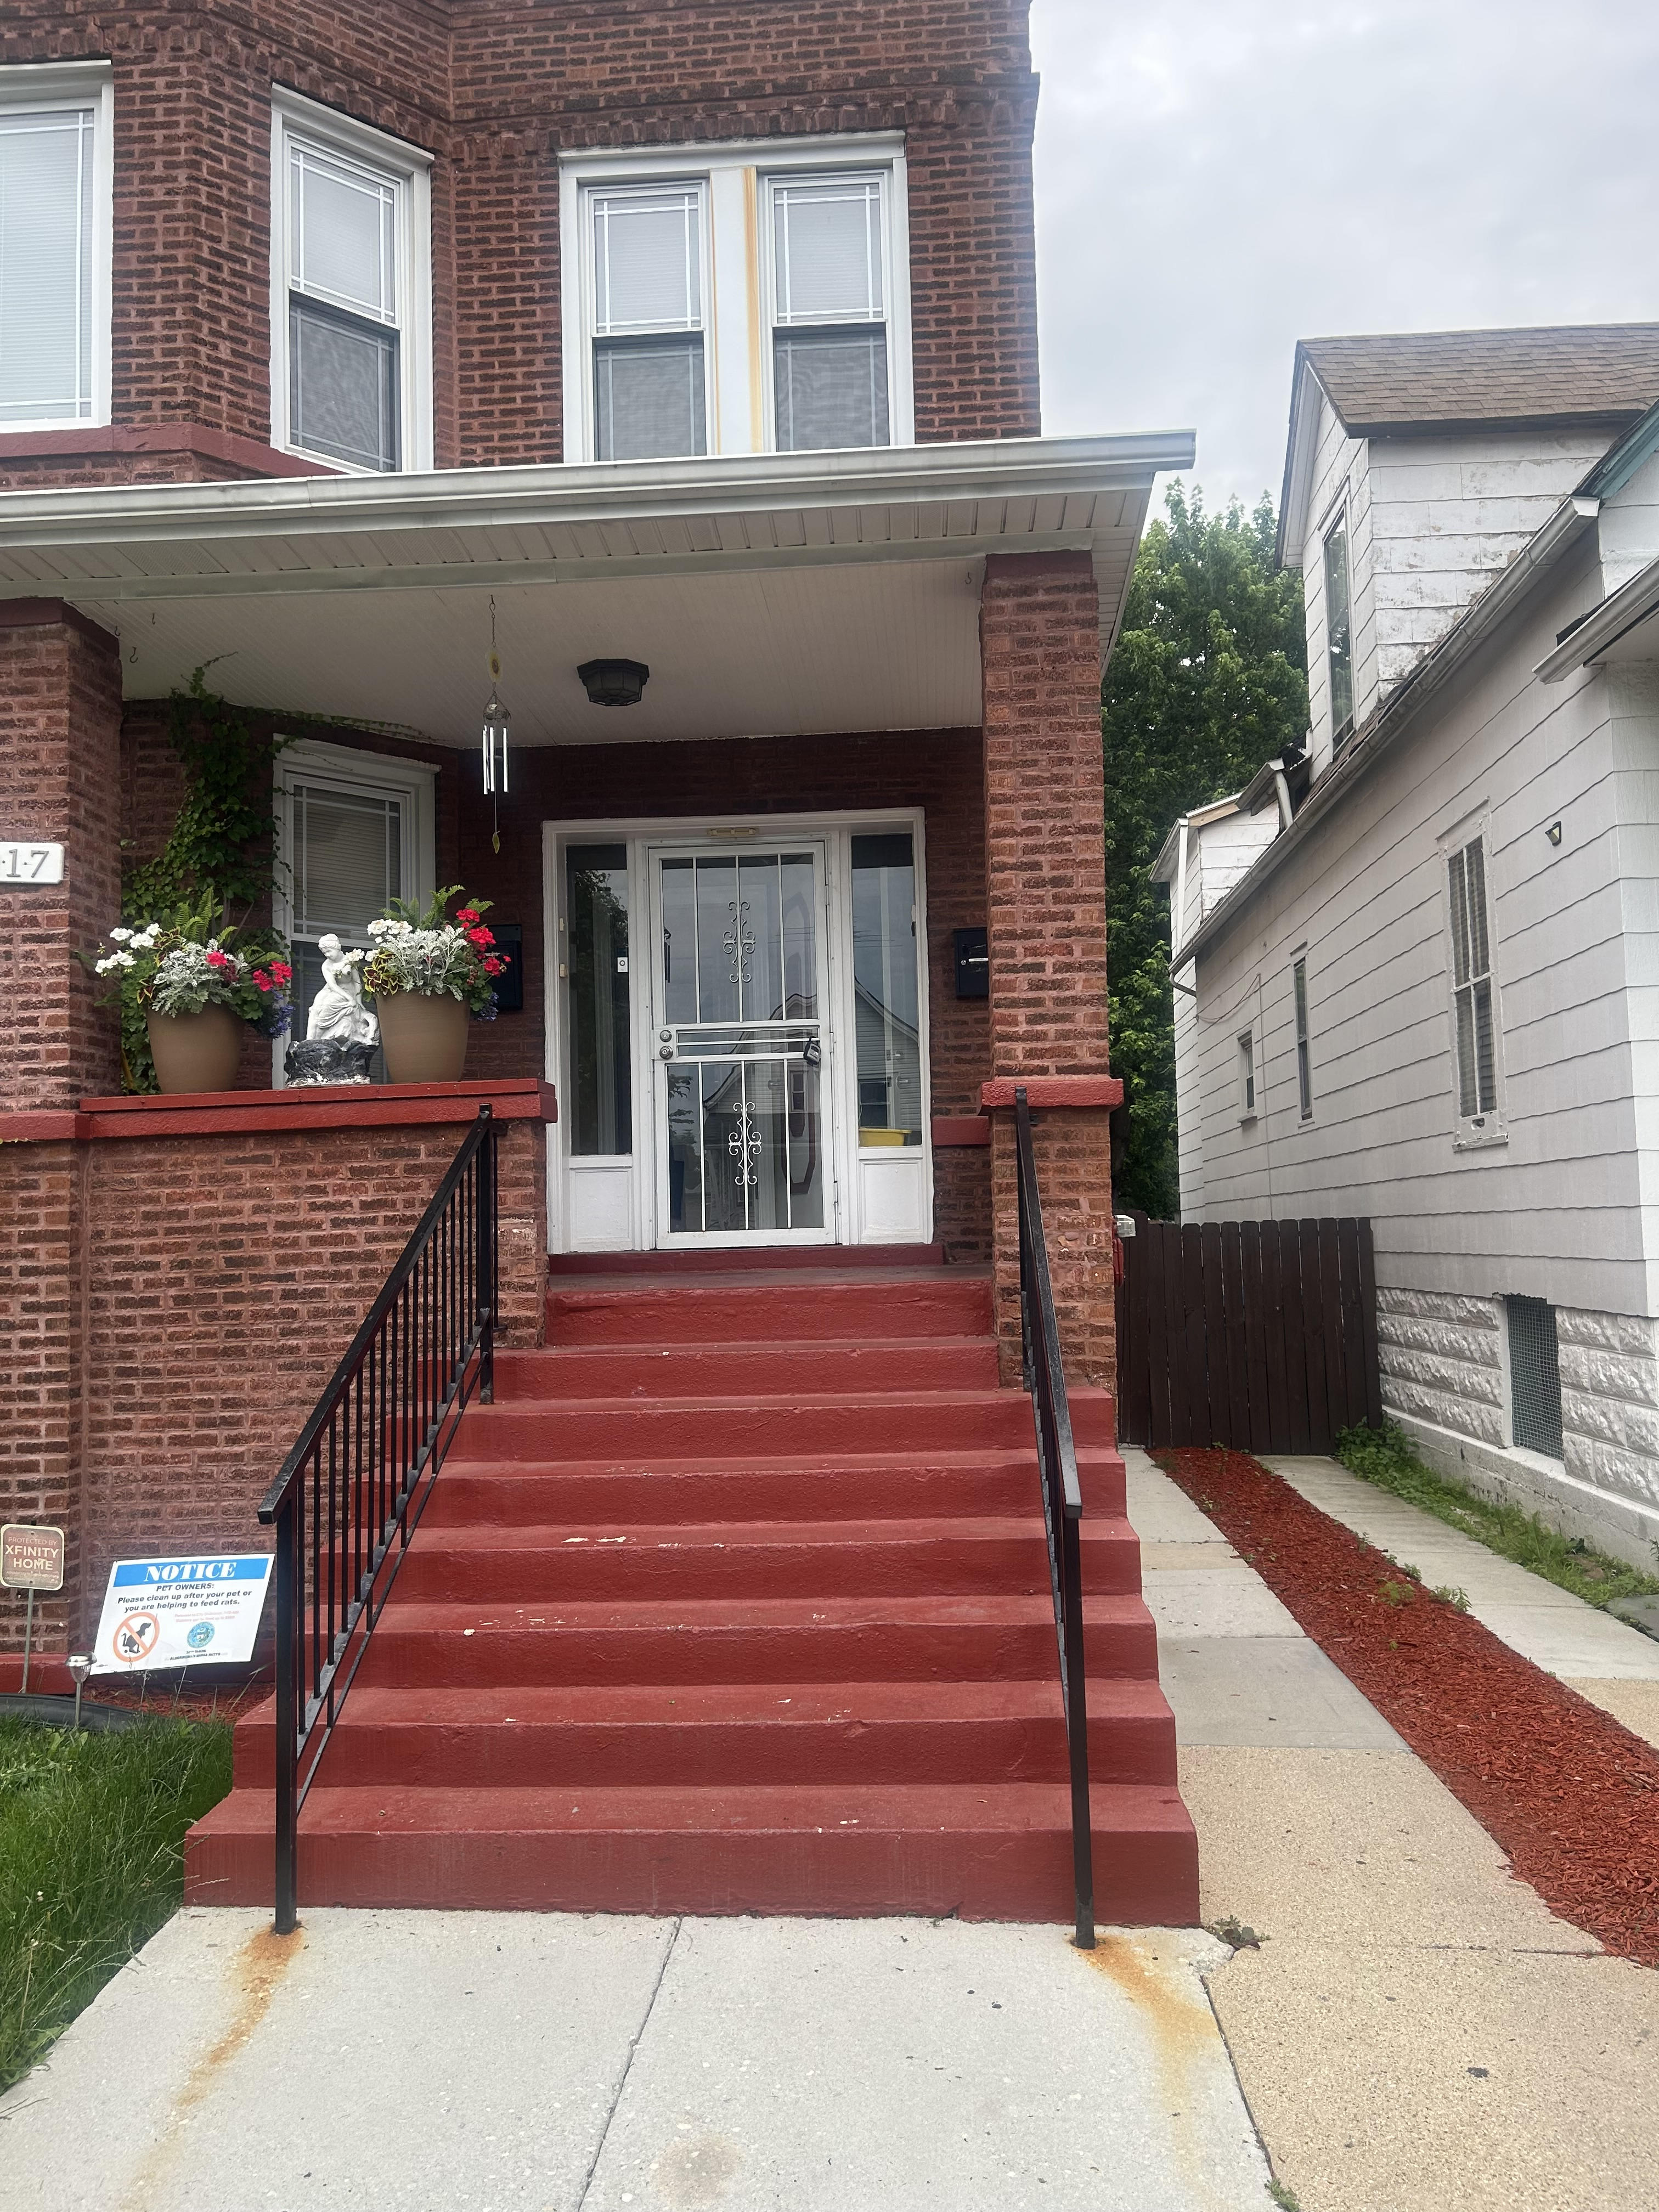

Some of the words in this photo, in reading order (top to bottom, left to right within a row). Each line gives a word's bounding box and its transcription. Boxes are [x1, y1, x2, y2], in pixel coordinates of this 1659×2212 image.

[8, 1537, 47, 1545] PROTECTED
[5, 1544, 59, 1558] XFINITY
[13, 1558, 53, 1571] HOME
[143, 1562, 237, 1582] NOTICE
[157, 1601, 188, 1610] helping
